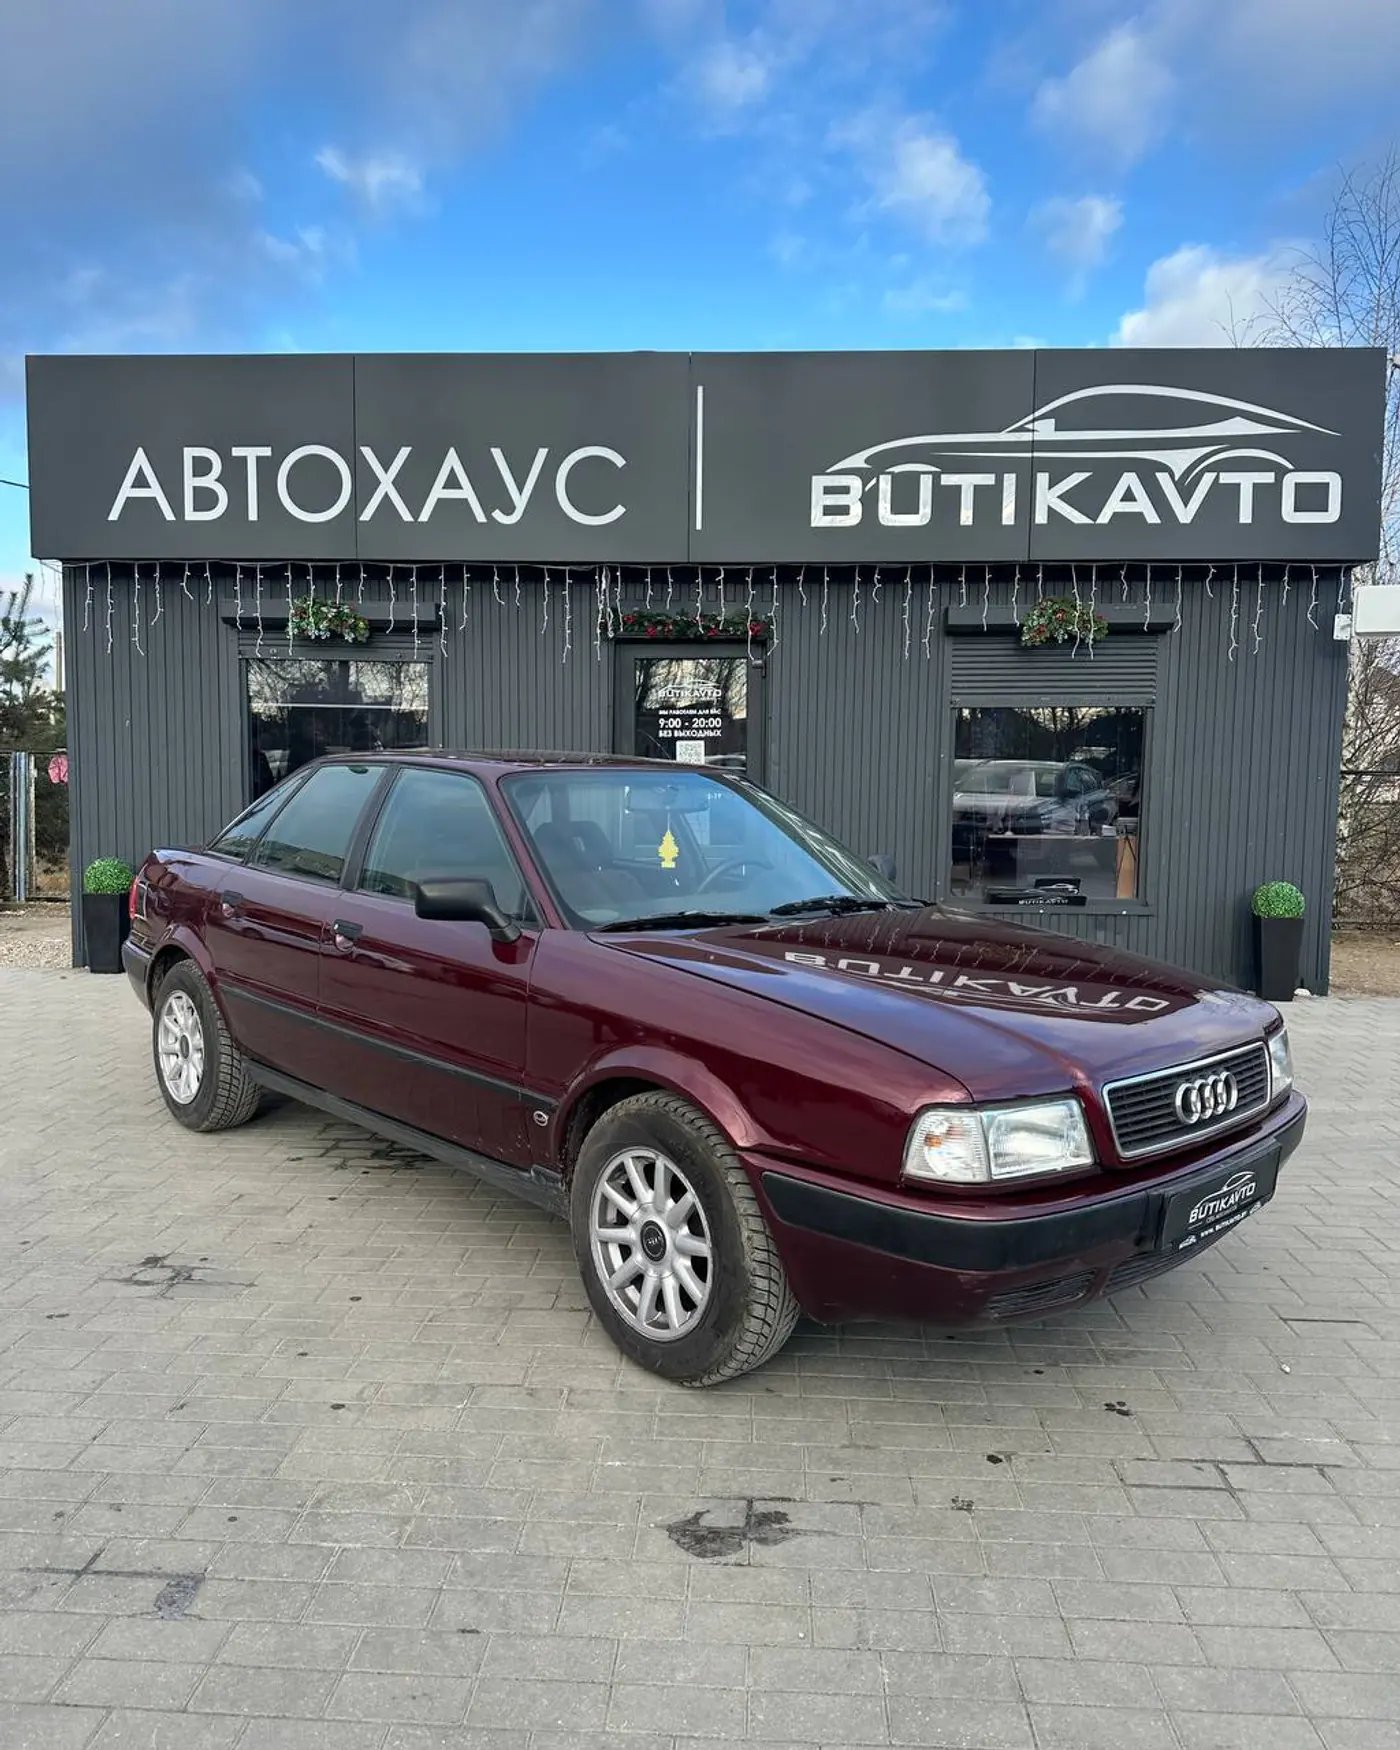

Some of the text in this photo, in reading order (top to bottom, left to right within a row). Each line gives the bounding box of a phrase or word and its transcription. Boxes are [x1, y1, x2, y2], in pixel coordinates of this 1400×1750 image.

[107, 445, 627, 525] АВТОХАУС
[810, 471, 1342, 528] BUTIKAVTO
[659, 717, 682, 728] 9:00
[692, 717, 722, 728] 20:00
[1189, 1182, 1256, 1223] BUTIKAVTO
